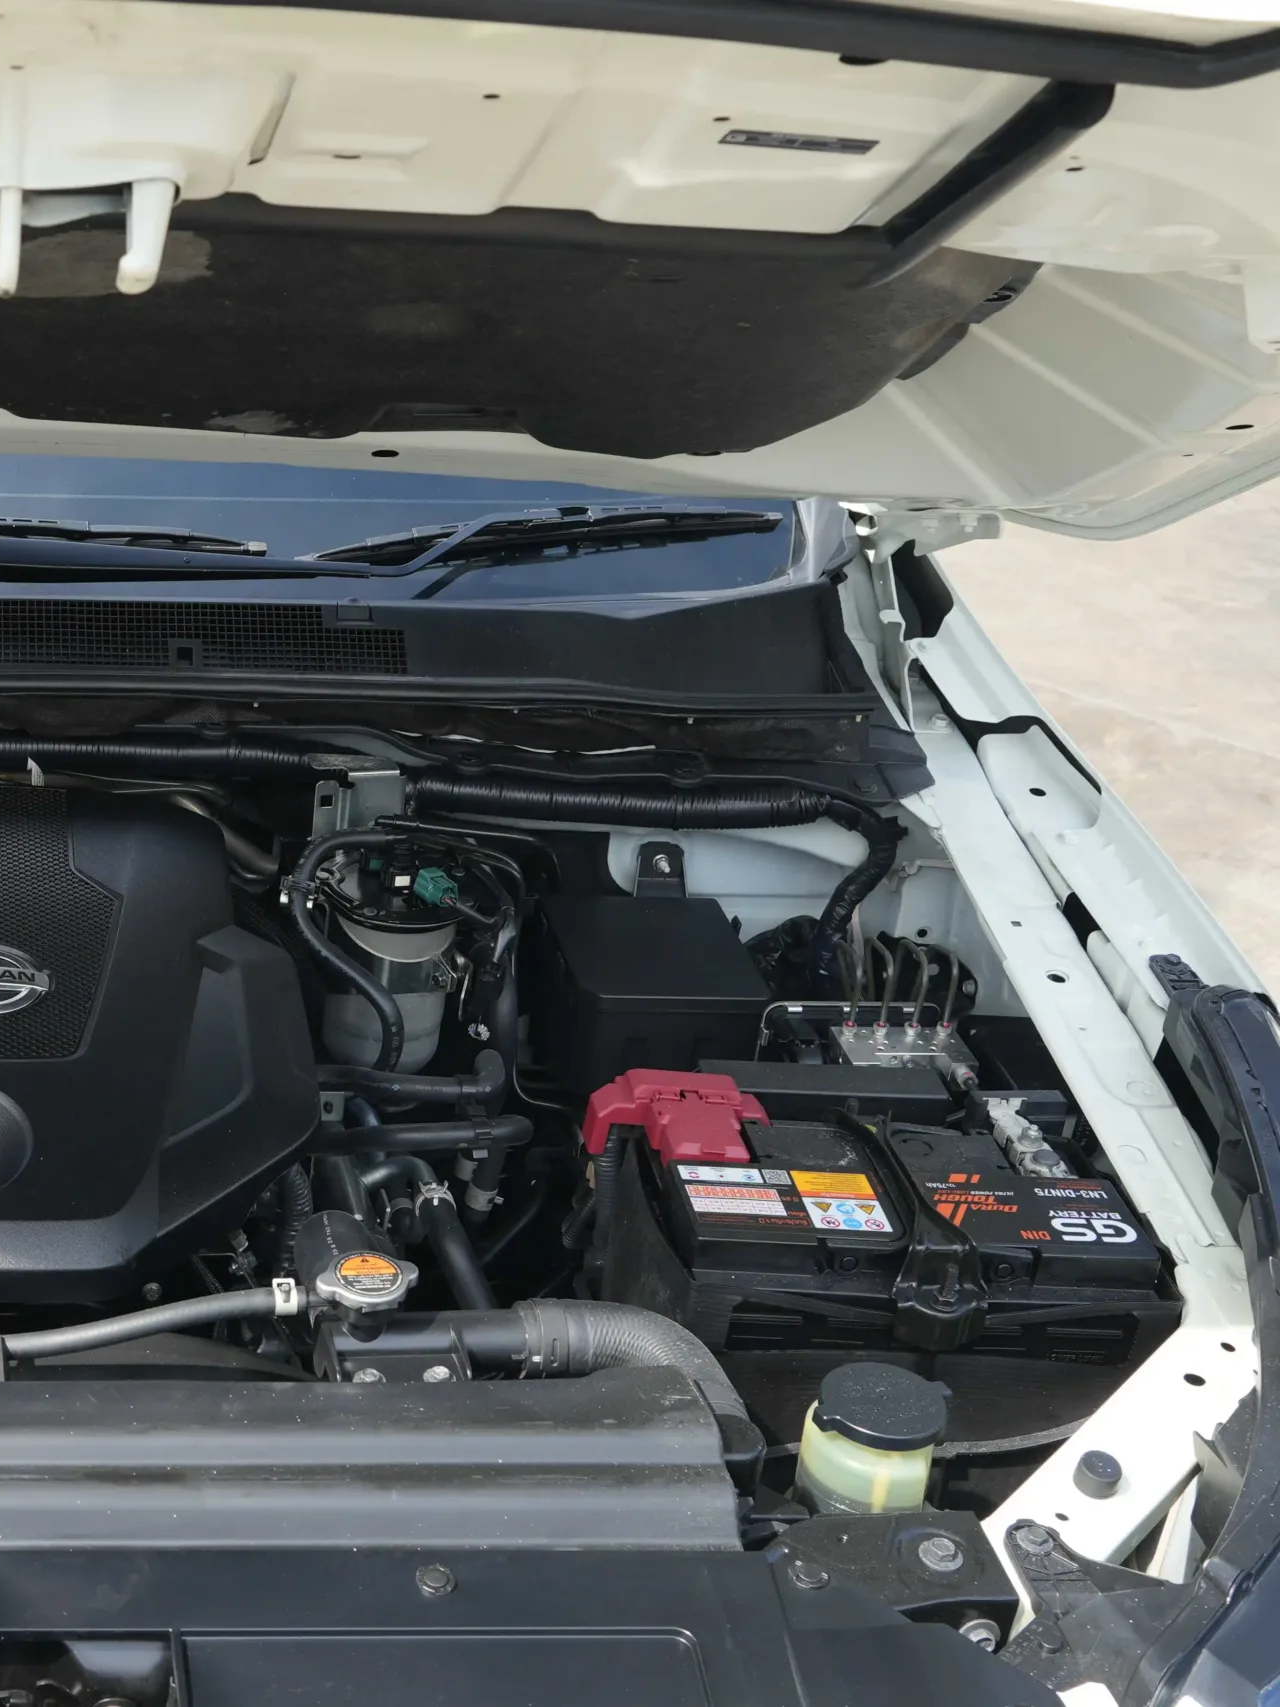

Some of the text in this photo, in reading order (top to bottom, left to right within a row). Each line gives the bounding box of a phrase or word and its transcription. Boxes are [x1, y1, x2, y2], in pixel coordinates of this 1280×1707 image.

[1034, 1187, 1109, 1199] LN3-DIN75
[933, 1194, 997, 1205] TOUGH
[970, 1203, 1019, 1213] DURA
[1048, 1209, 1122, 1220] BATTERY
[1020, 1217, 1138, 1244] GS DIN
